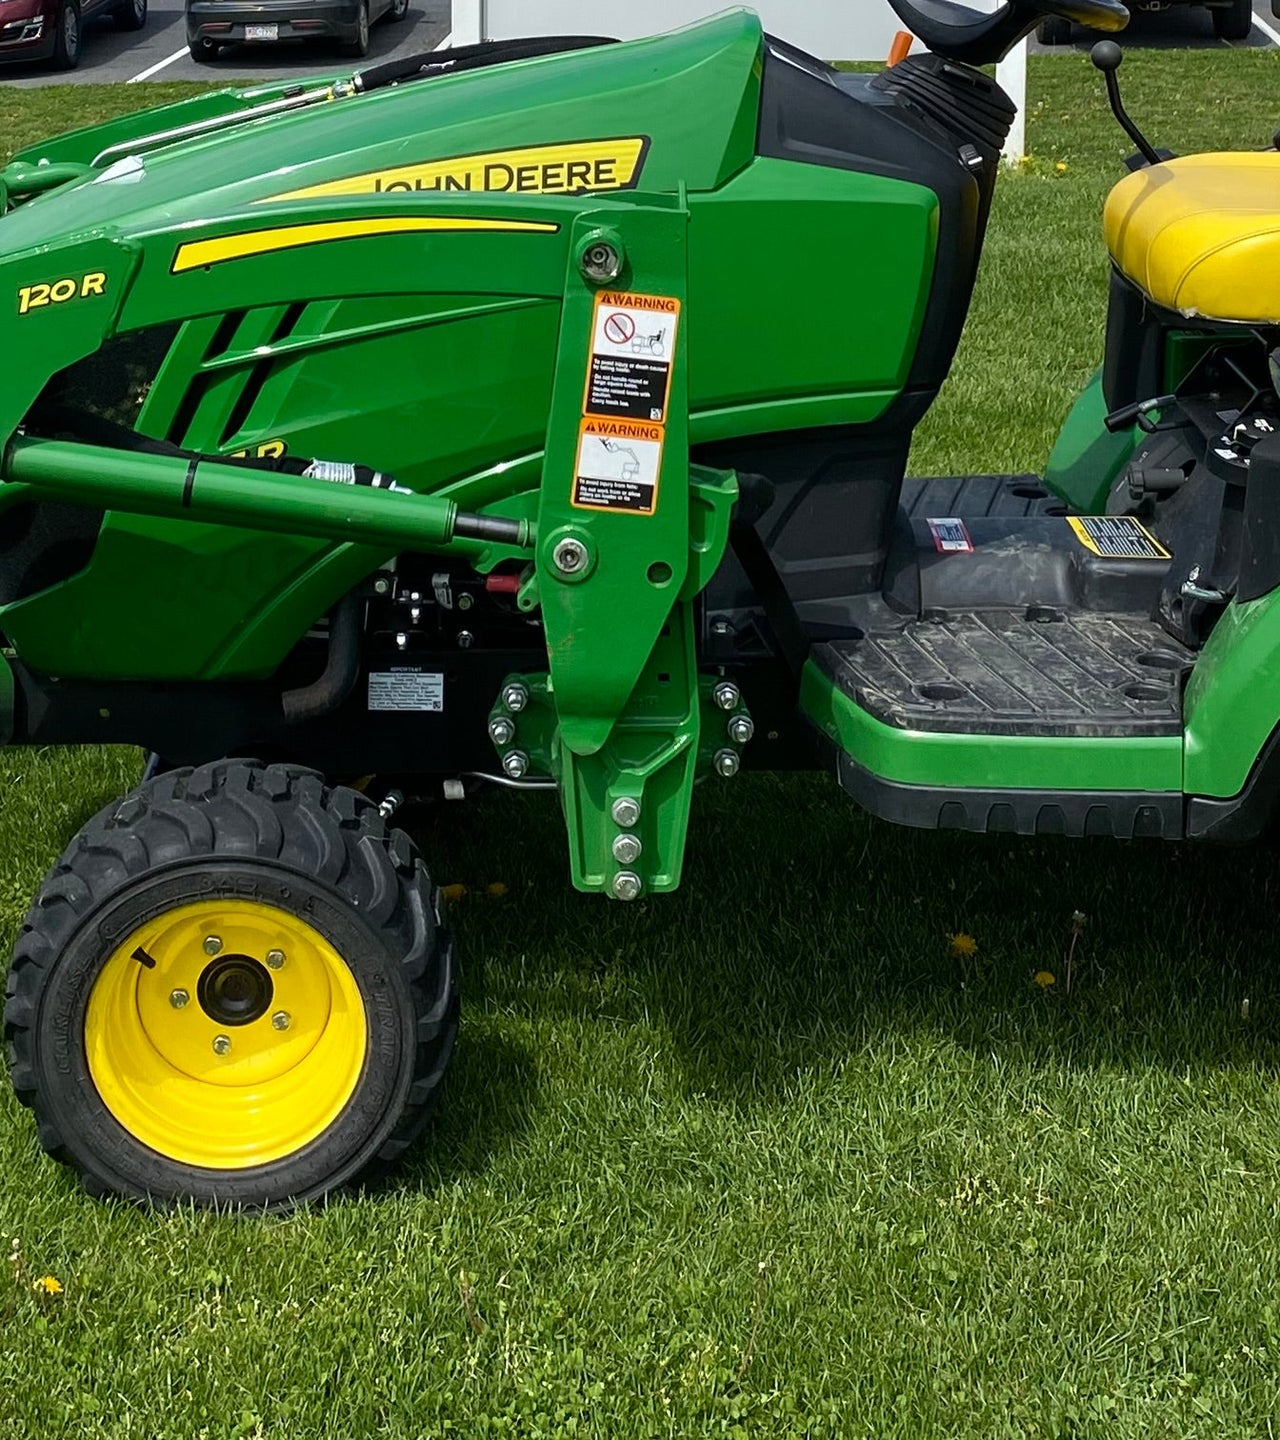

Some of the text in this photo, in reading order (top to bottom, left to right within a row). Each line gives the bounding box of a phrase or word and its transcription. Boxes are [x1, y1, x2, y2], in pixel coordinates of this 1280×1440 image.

[483, 158, 617, 192] DEERE
[613, 294, 676, 312] WARNING
[598, 426, 660, 440] WARNING
